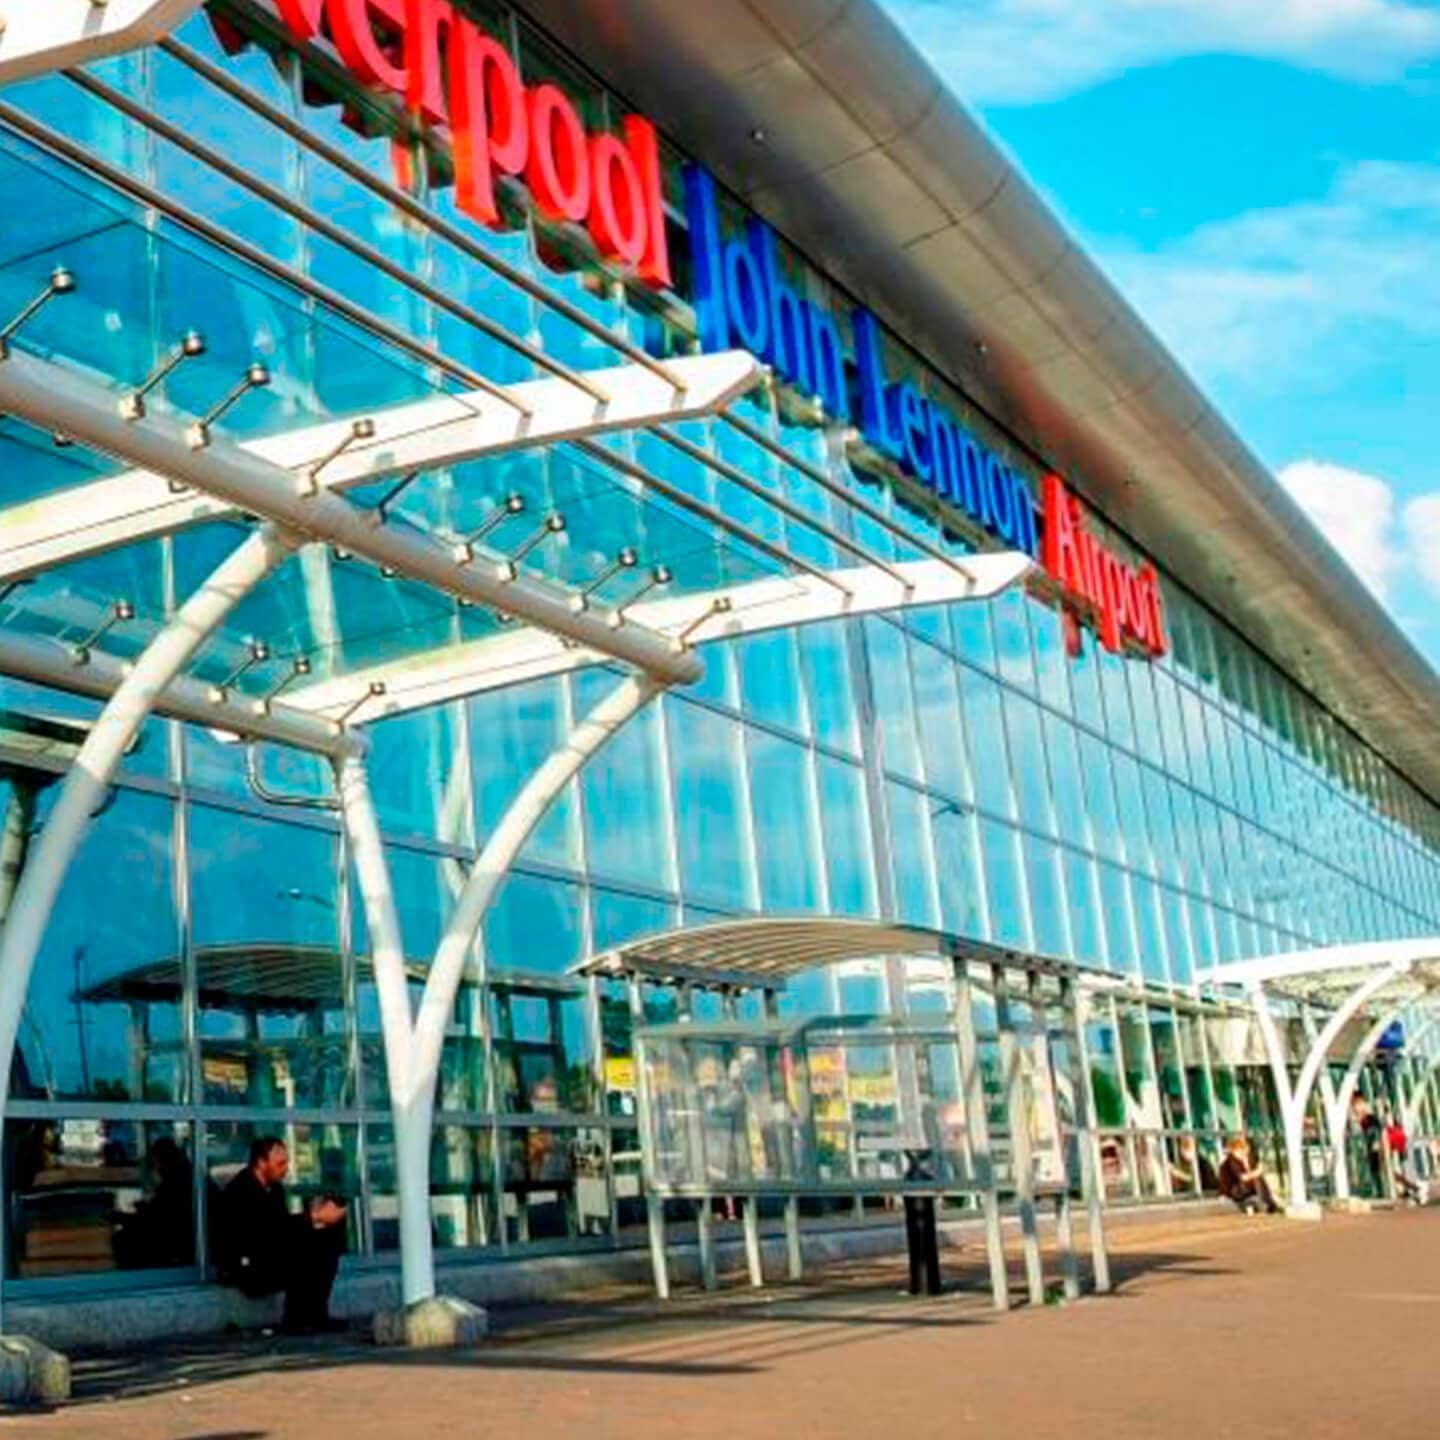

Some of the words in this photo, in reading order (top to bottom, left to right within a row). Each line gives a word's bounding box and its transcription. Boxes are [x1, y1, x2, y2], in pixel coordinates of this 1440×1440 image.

[274, 0, 672, 288] erpool
[681, 159, 850, 422] John
[850, 306, 1038, 557] Lennon
[1041, 472, 1166, 656] Airport
